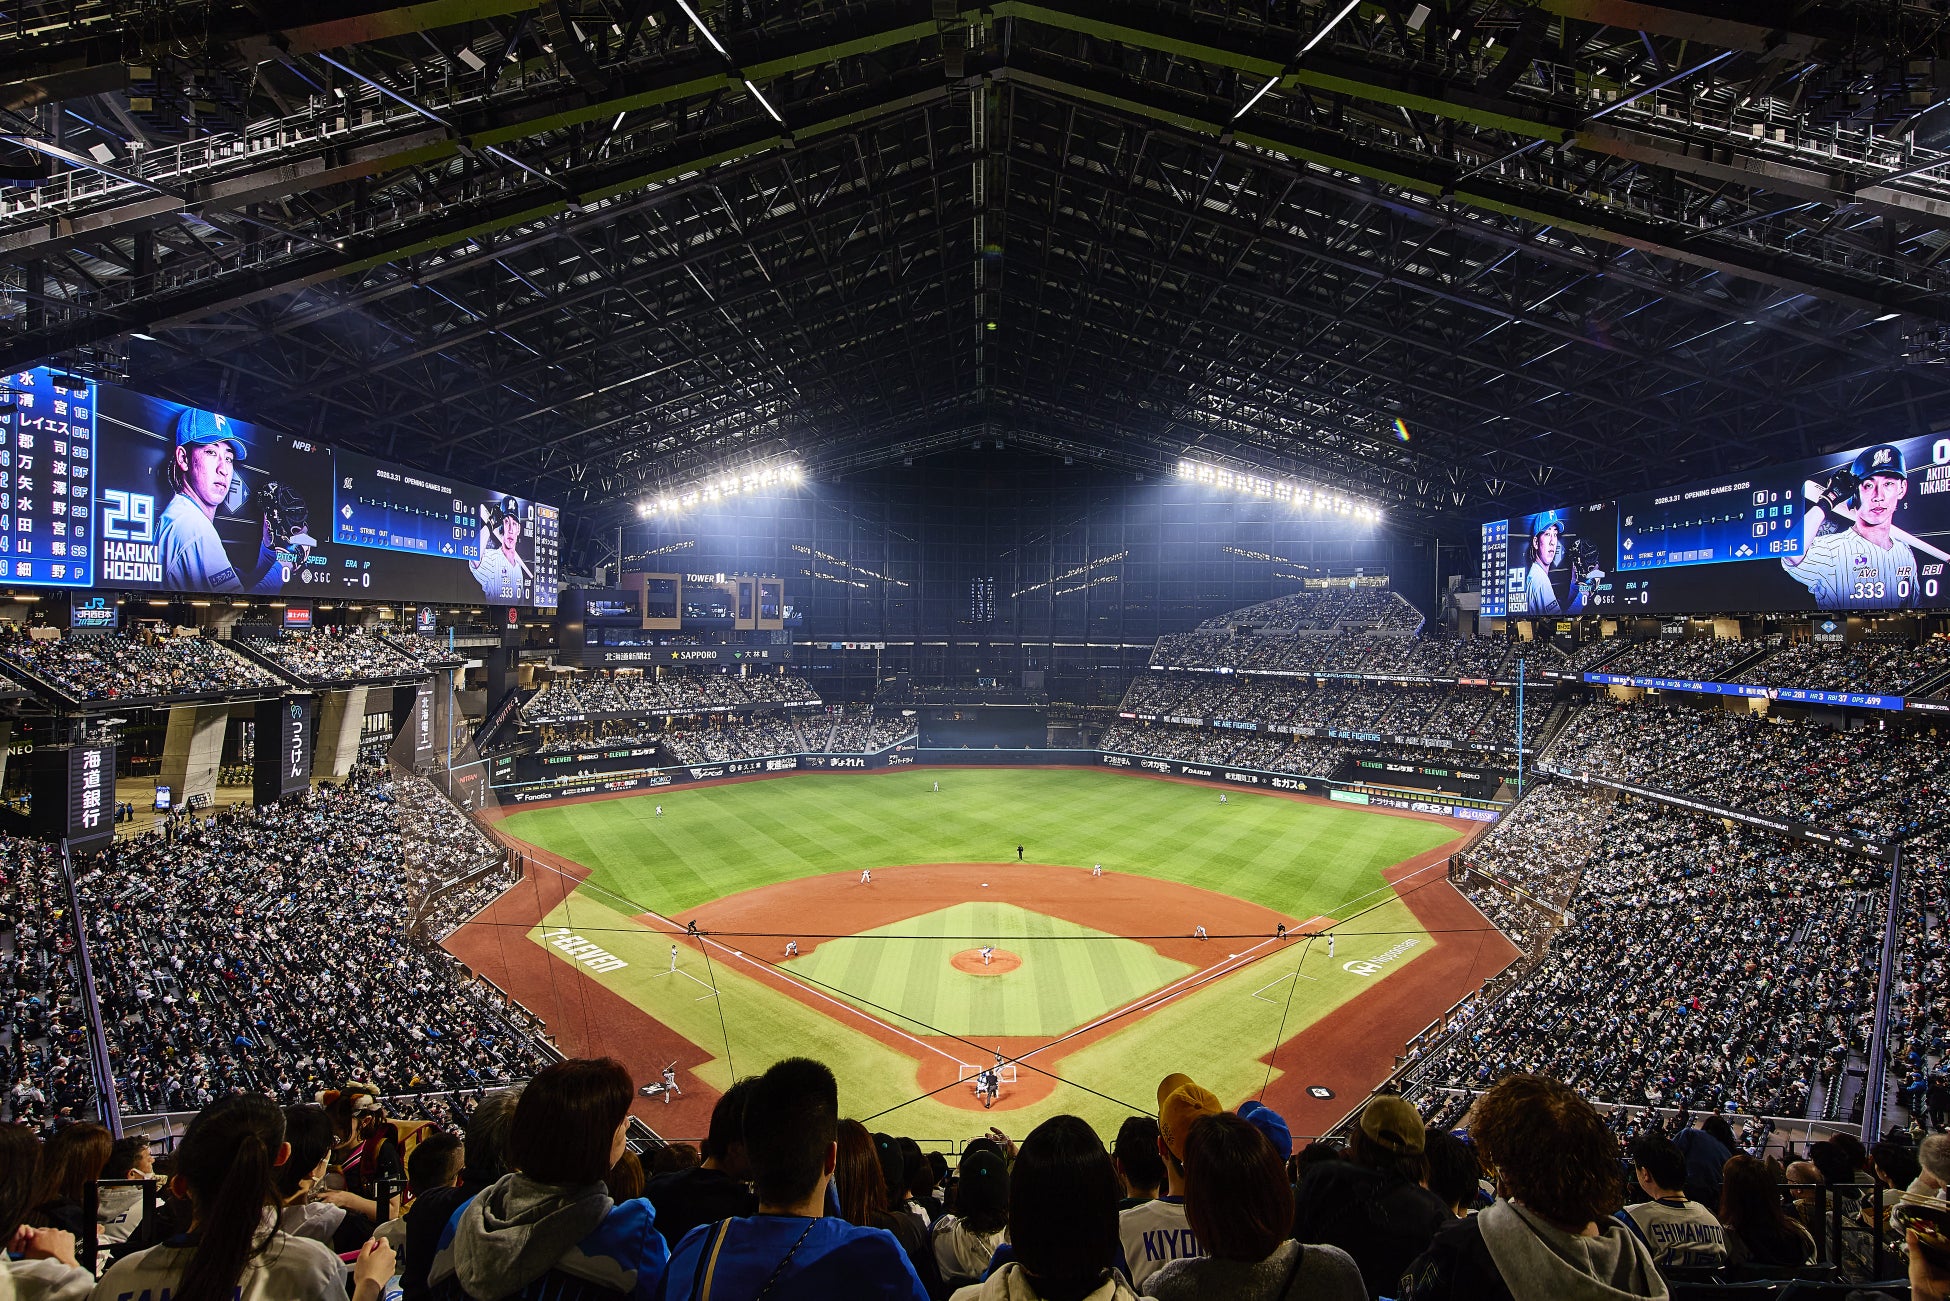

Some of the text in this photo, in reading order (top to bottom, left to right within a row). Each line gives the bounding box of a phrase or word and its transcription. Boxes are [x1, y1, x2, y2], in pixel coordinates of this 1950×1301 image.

[74, 407, 88, 420] 1B
[20, 412, 69, 435] レイエス
[72, 426, 89, 439] DH
[72, 446, 88, 459] 3B
[72, 466, 88, 478] RF
[404, 477, 424, 488] OPENING
[72, 486, 88, 498] CF
[1684, 489, 1710, 500] OPENING
[1710, 485, 1732, 496] GAMES
[1734, 482, 1750, 491] 2026
[1757, 491, 1792, 503] 0 0 0
[72, 506, 88, 518] 2B
[104, 489, 154, 542] 29
[75, 526, 84, 537] C
[360, 528, 376, 536] STRIKE
[1756, 519, 1790, 535] 0 0 0
[71, 545, 88, 557] SS
[104, 541, 158, 563] HARUKI
[463, 546, 478, 556] 18:36
[1770, 539, 1798, 553] 18:36
[276, 553, 327, 565] PITCH SPEED
[345, 560, 358, 568] ERA
[74, 568, 84, 578] P
[104, 561, 162, 582] HOSONO
[282, 566, 330, 583] 0 SGC
[1858, 569, 1878, 578] AVG
[1897, 567, 1912, 576] HR
[1922, 564, 1944, 576] RBI
[362, 573, 370, 587] 0
[686, 574, 714, 582] TOWER
[1509, 568, 1525, 592] 29
[500, 587, 530, 599] .333 0 0
[1850, 579, 1938, 599] .333 0 0
[1509, 593, 1526, 602] HARUKI
[1582, 594, 1614, 606] 0 SGC
[1641, 591, 1648, 604] 0
[85, 598, 104, 610] JR
[1509, 603, 1528, 612] HOSONO
[78, 610, 112, 618] JR西日本
[680, 651, 716, 660] SAPPORO
[1865, 697, 1880, 705] .699
[1233, 722, 1256, 730] FIGHTERS
[1352, 732, 1380, 742] FIGHTERS
[291, 722, 303, 778] つうけん
[544, 751, 628, 764] 7-ELEVEN 7-ELEVEN
[830, 758, 865, 766] ぎょれん
[1148, 760, 1170, 770] オカモト
[1356, 760, 1382, 770] 7-ELEVEN
[1188, 768, 1212, 776] DAIKIN
[1419, 767, 1448, 776] 7-ELEVEN
[82, 750, 101, 828] 海道銀行
[610, 780, 638, 788] KOTOBUKI
[1272, 778, 1298, 790] 北ガス
[524, 792, 552, 801] Fanatics
[1472, 812, 1494, 820] CLASSIC
[540, 928, 629, 974] 7-ELEVEN
[1652, 1224, 1724, 1244] SHIMAMOTO
[1143, 1229, 1203, 1261] KIYO
